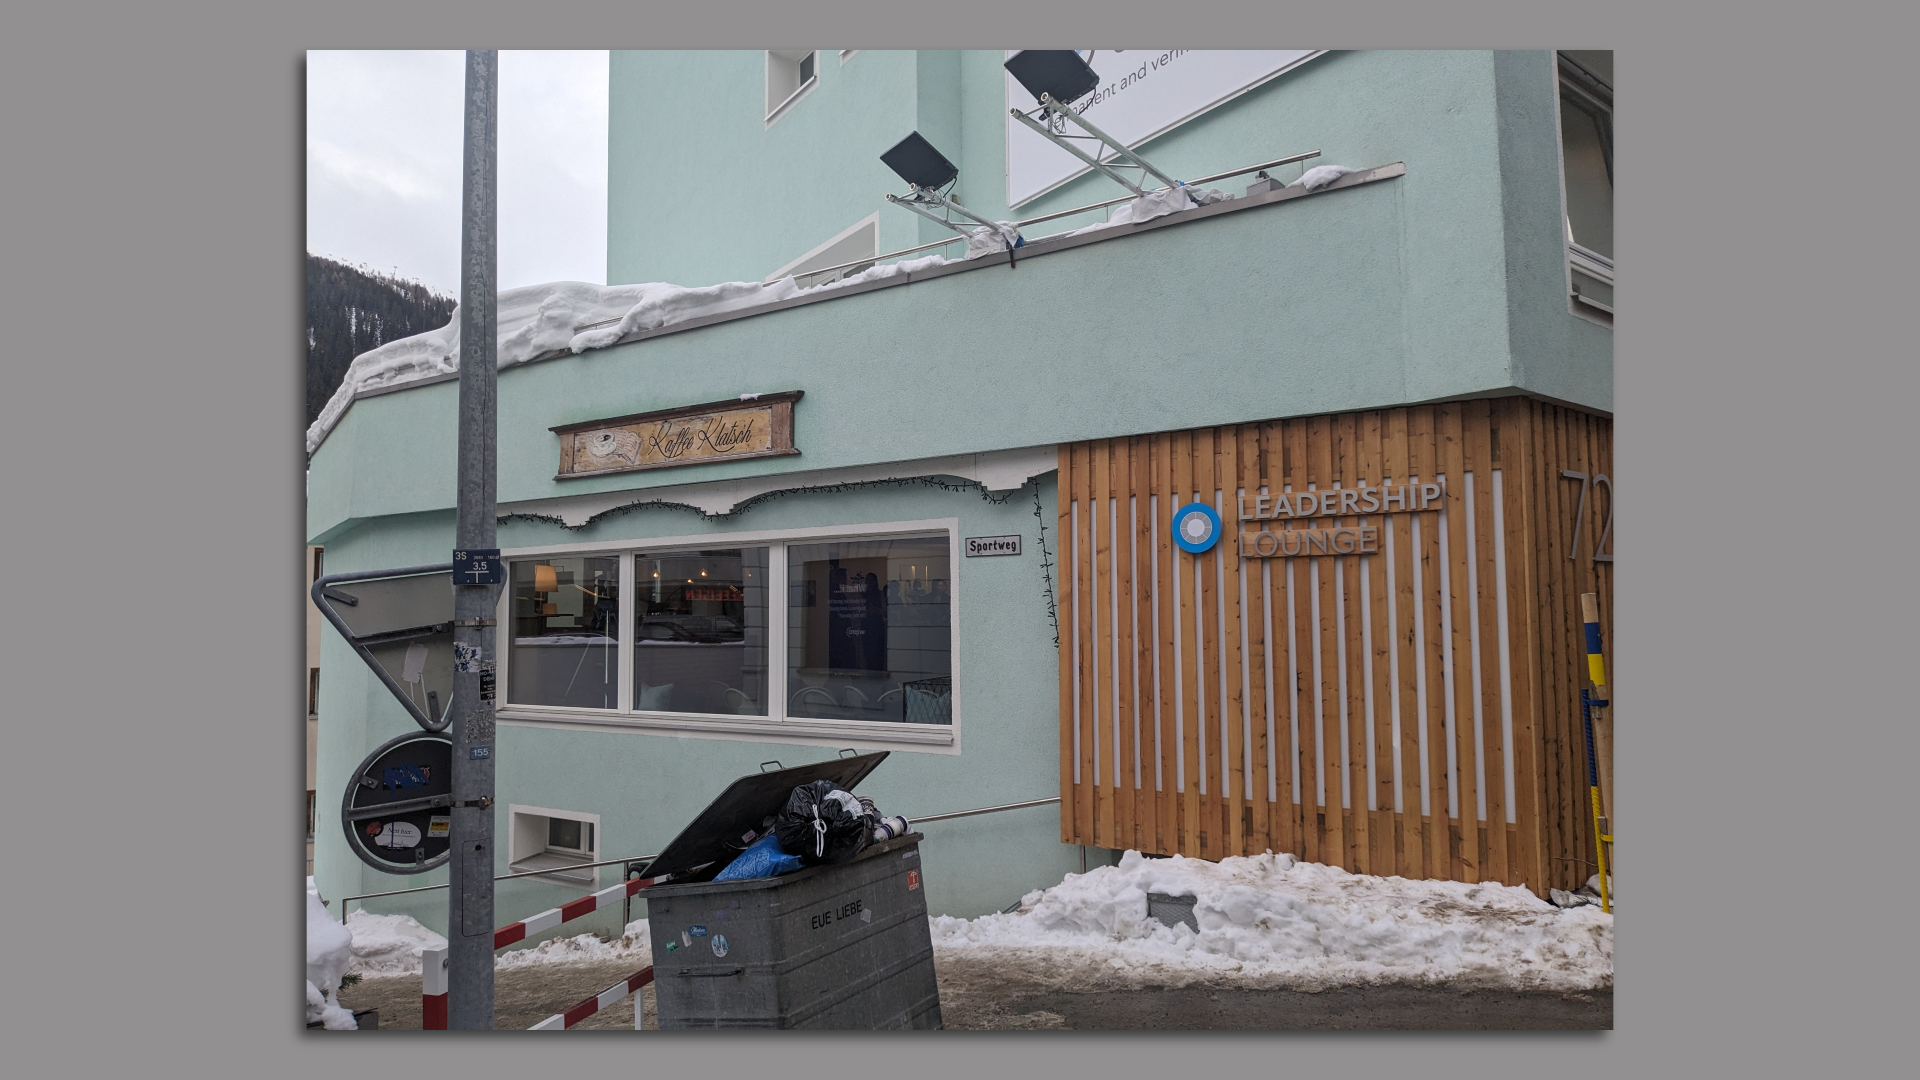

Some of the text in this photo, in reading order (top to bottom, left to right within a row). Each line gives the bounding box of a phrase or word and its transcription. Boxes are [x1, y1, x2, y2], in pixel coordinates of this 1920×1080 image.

[1120, 61, 1147, 91] and
[647, 416, 754, 459] Kaffee Klatsch
[1238, 483, 1441, 520] LEADERSHIP
[1561, 469, 1613, 561] 72
[455, 551, 467, 561] 3S
[970, 540, 1017, 554] Sportweg
[1239, 527, 1376, 557] LOUNGE
[473, 747, 489, 757] 155
[811, 899, 863, 930] EUE LIEBE
